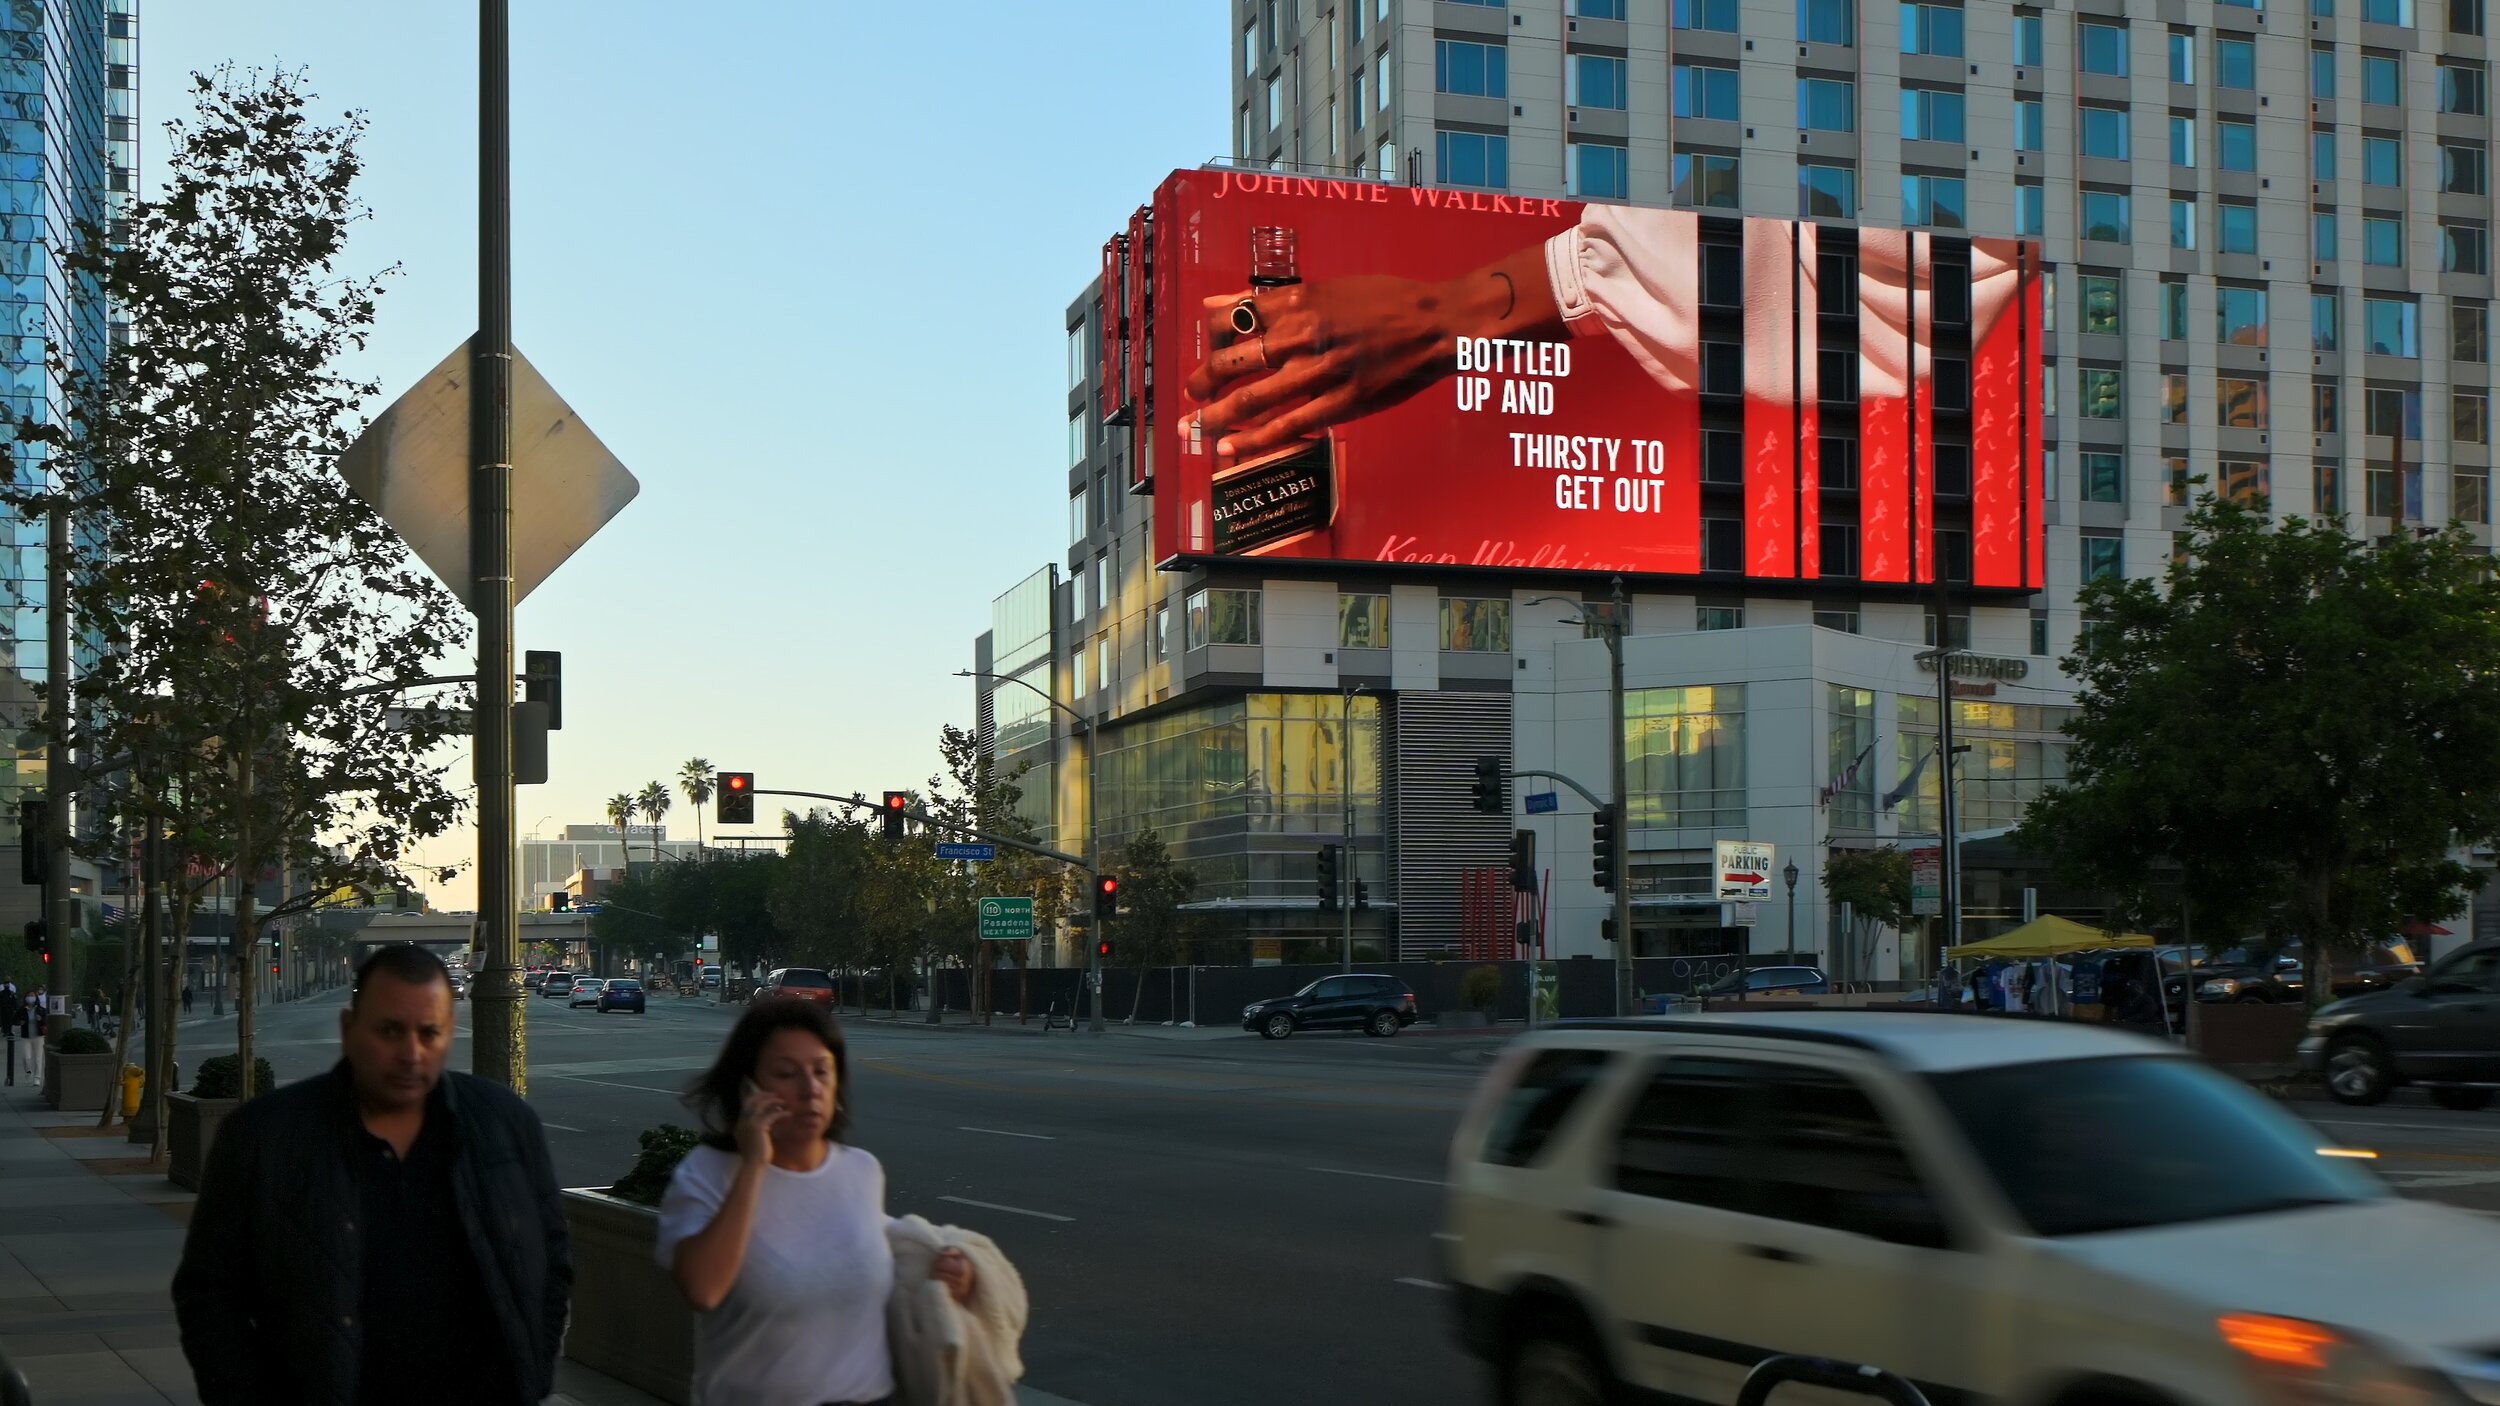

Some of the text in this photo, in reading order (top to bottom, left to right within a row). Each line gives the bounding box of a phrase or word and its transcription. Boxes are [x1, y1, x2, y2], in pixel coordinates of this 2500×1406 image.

[1214, 172, 1561, 217] JOHNNIE WALKER
[1456, 336, 1571, 377] BOTTLED
[1456, 376, 1554, 416] UP AND
[1509, 432, 1664, 475] THIRSTY TO
[1555, 474, 1665, 513] GET OUT
[1213, 494, 1265, 521] BLACK
[940, 846, 993, 856] Francisco St
[1721, 855, 1768, 871] PARKING
[1734, 846, 1758, 855] PUBLIC
[983, 919, 1029, 927] Pasadena
[986, 906, 998, 914] 110
